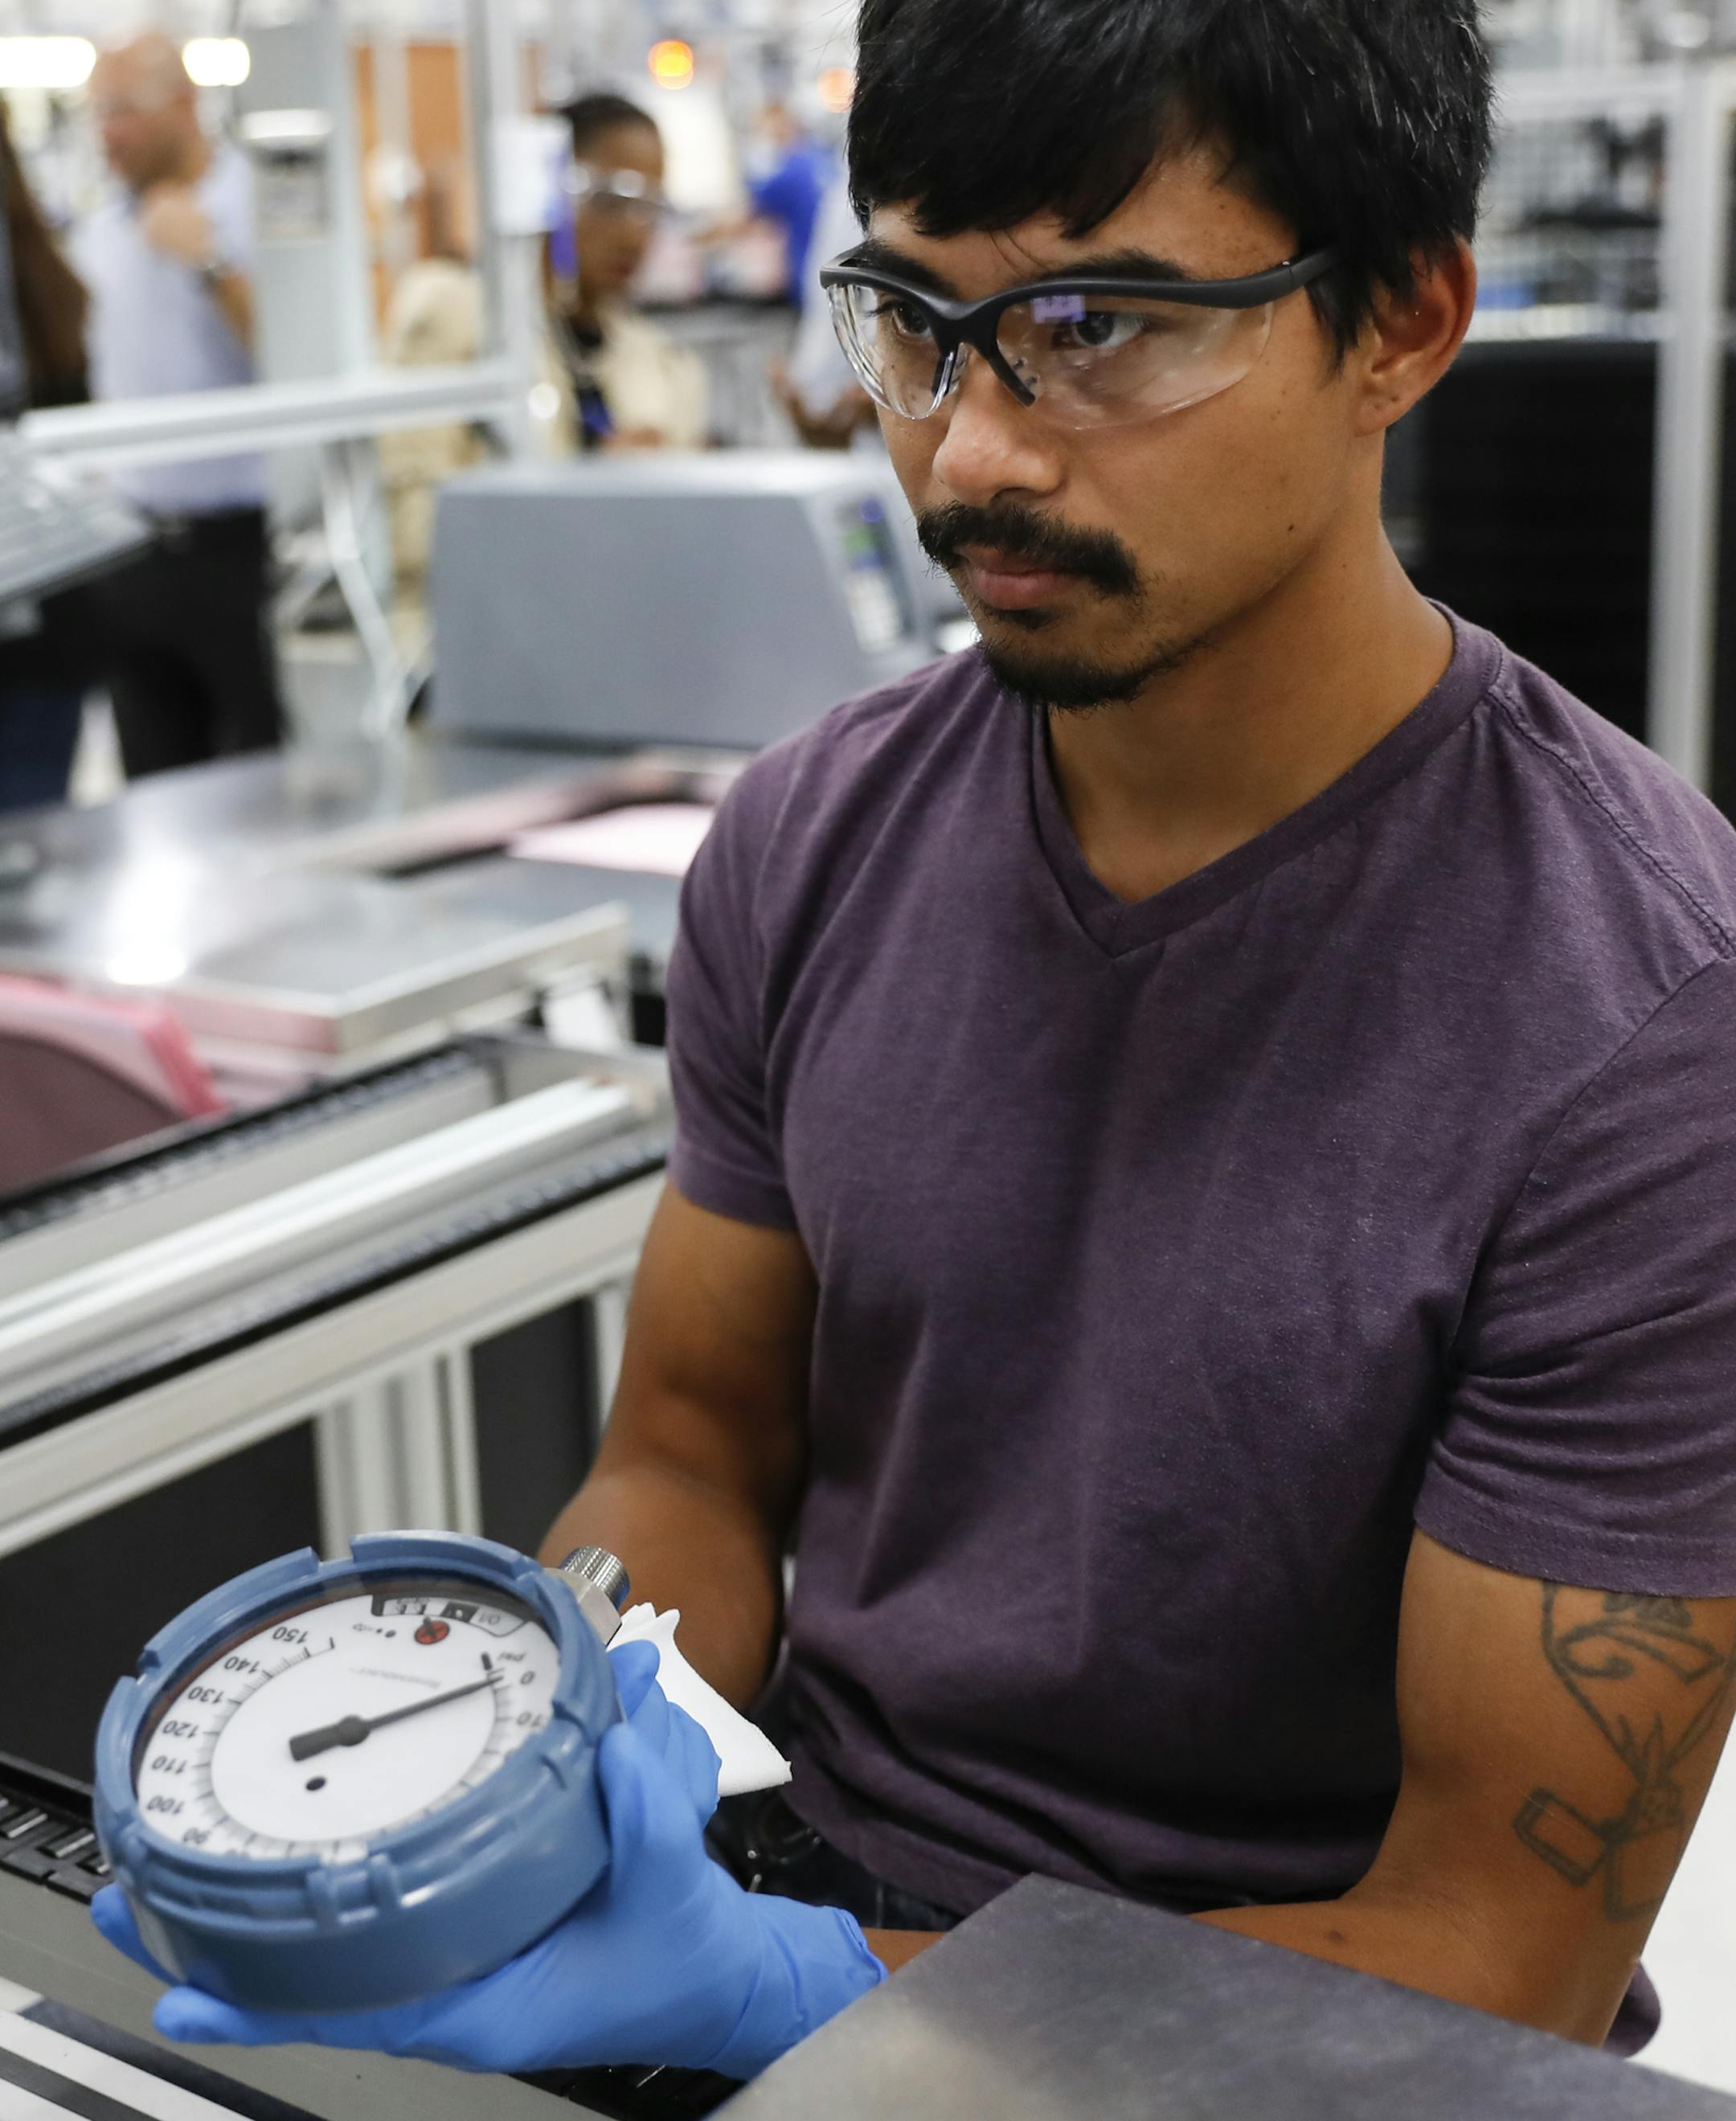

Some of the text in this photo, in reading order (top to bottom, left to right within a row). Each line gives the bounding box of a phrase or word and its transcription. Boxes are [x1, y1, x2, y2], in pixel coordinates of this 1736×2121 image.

[273, 1627, 308, 1644] 150
[225, 1656, 260, 1673] 140
[520, 1672, 535, 1685] 0
[189, 1687, 223, 1703] 130
[164, 1721, 199, 1737] 120
[153, 1756, 186, 1773] 110
[147, 1796, 183, 1814] 100
[184, 1828, 208, 1844] 90
